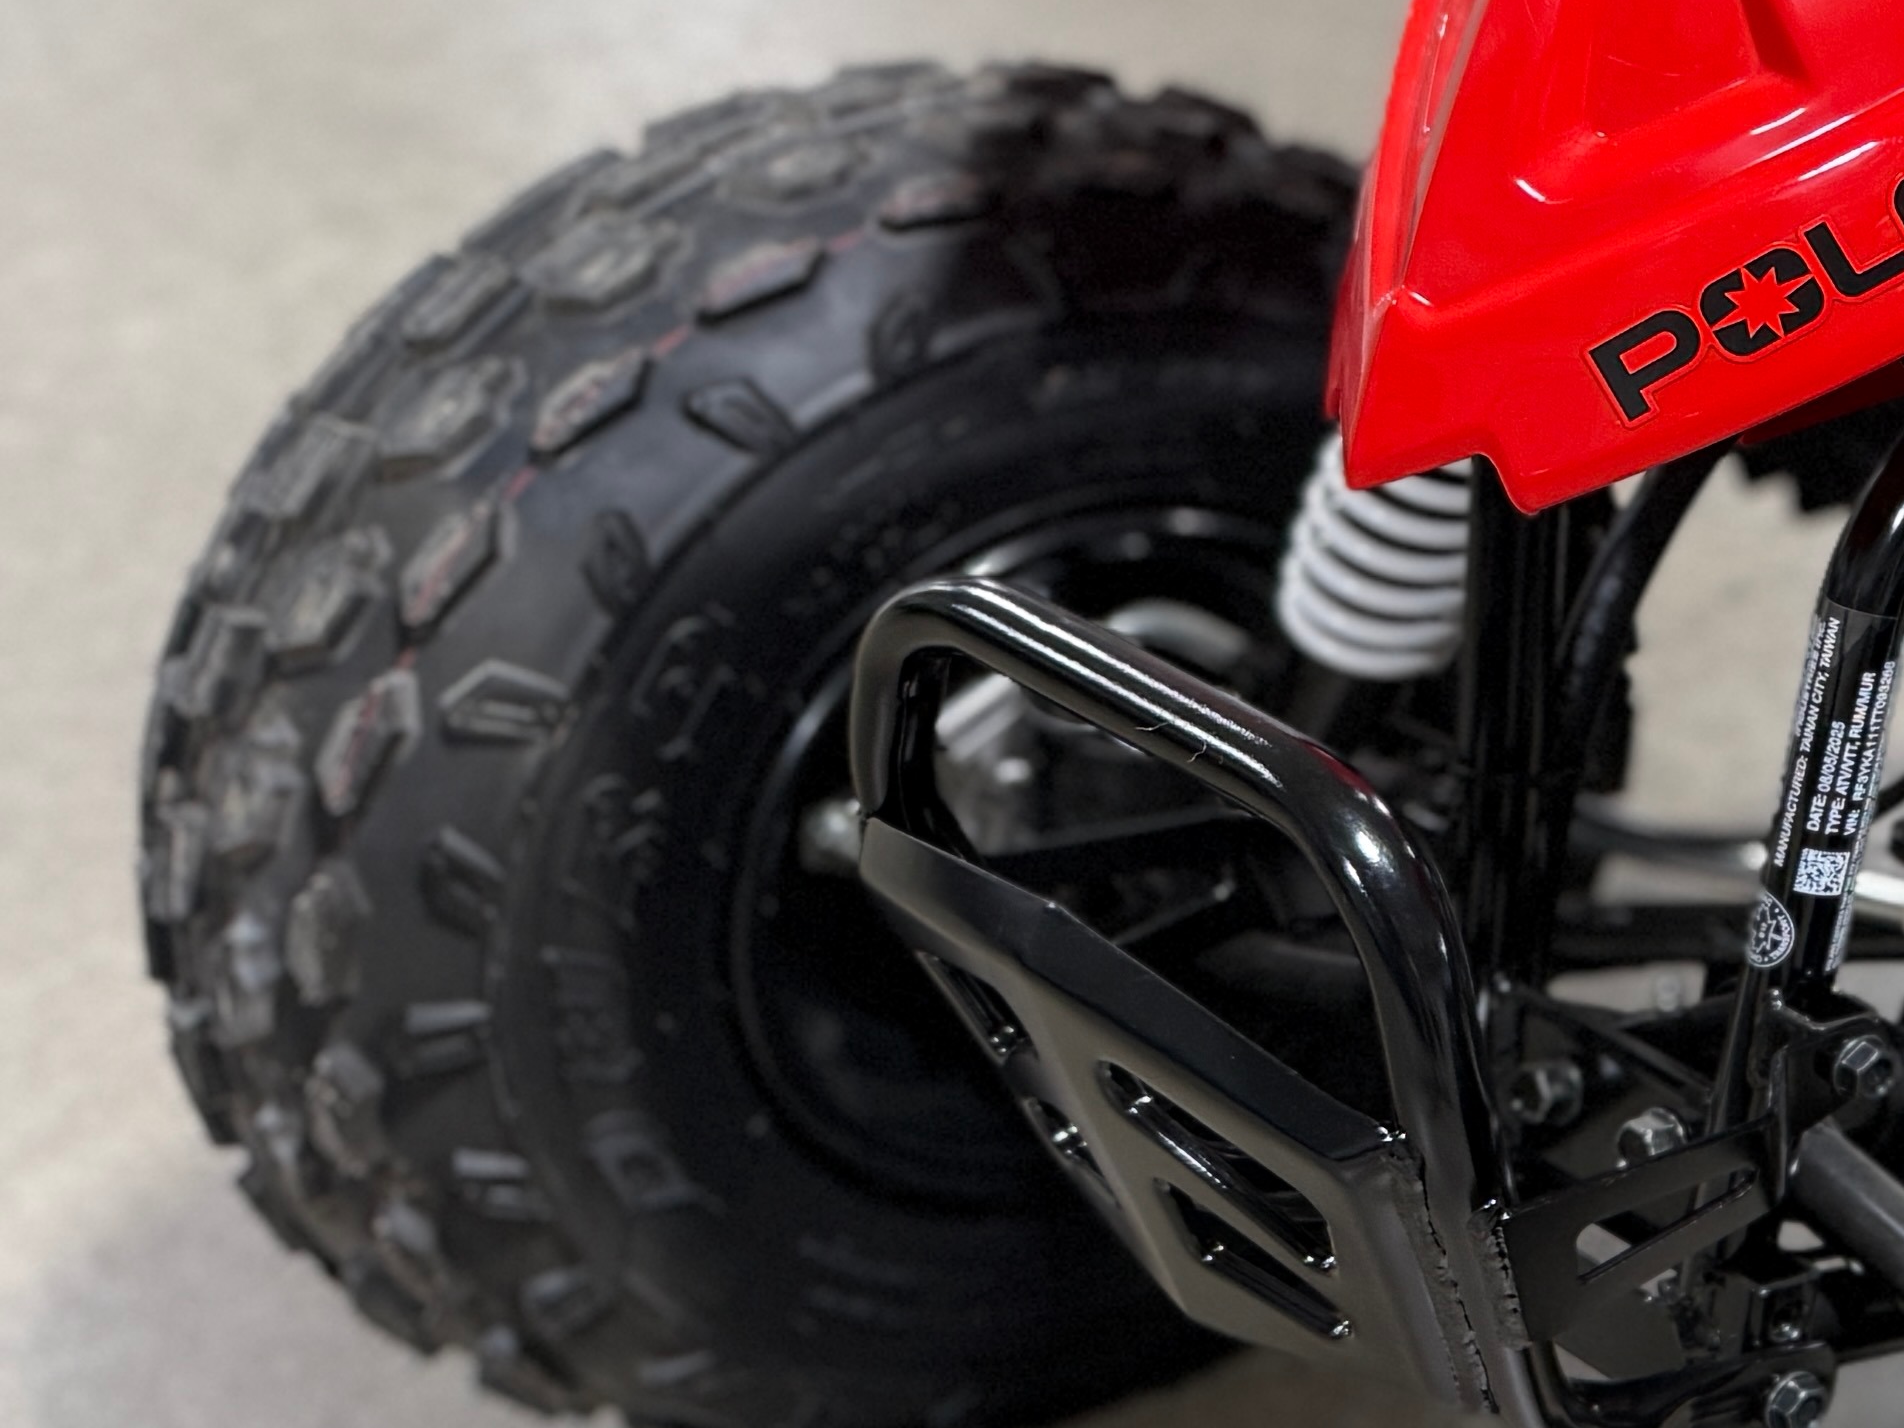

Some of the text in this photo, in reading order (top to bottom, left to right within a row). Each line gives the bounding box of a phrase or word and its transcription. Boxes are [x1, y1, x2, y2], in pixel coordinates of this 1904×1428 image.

[1773, 616, 1841, 867] MANUFACTURED: TAINAN CITY, TAIWAN
[1806, 720, 1846, 832] DATE: 08/05/2025
[1824, 797, 1846, 835] TYPE:
[1843, 809, 1861, 836] VIN:
